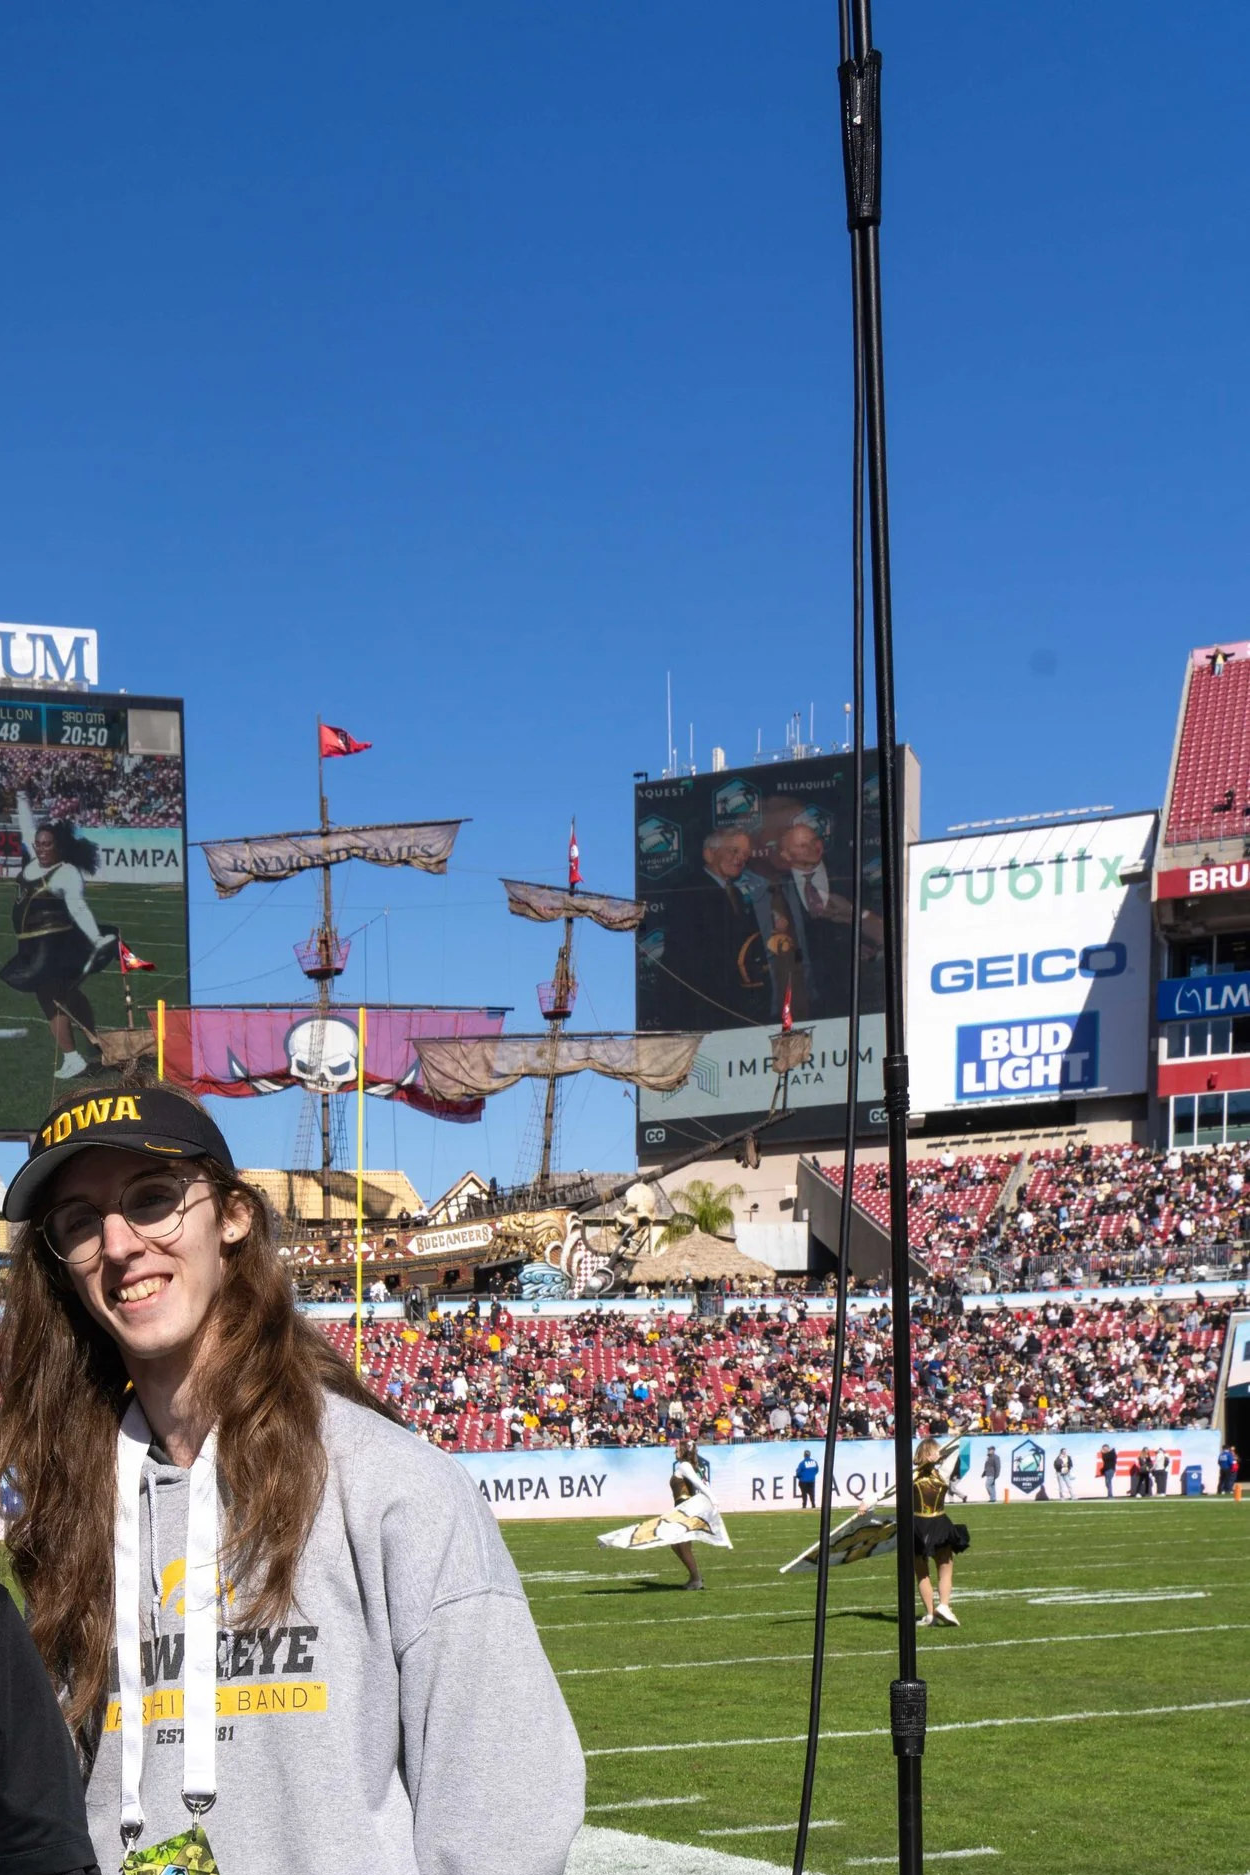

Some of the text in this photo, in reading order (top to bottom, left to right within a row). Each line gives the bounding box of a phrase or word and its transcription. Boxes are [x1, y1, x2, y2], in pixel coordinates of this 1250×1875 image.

[16, 708, 33, 722] ON
[61, 711, 106, 725] 3RD QTR
[60, 725, 108, 747] 20:50
[102, 846, 180, 868] TAMPA
[1189, 863, 1250, 893] BRU
[930, 941, 1128, 995] GEICO
[1205, 983, 1250, 1011] LM
[980, 1021, 1073, 1061] BUD
[727, 1046, 873, 1078] IMPRIUM
[962, 1052, 1090, 1094] LIGHT
[41, 1095, 142, 1147] IOWA
[416, 1226, 490, 1254] BUCCANEERS
[559, 1474, 608, 1498] BAY
[237, 1687, 309, 1712] BAND
